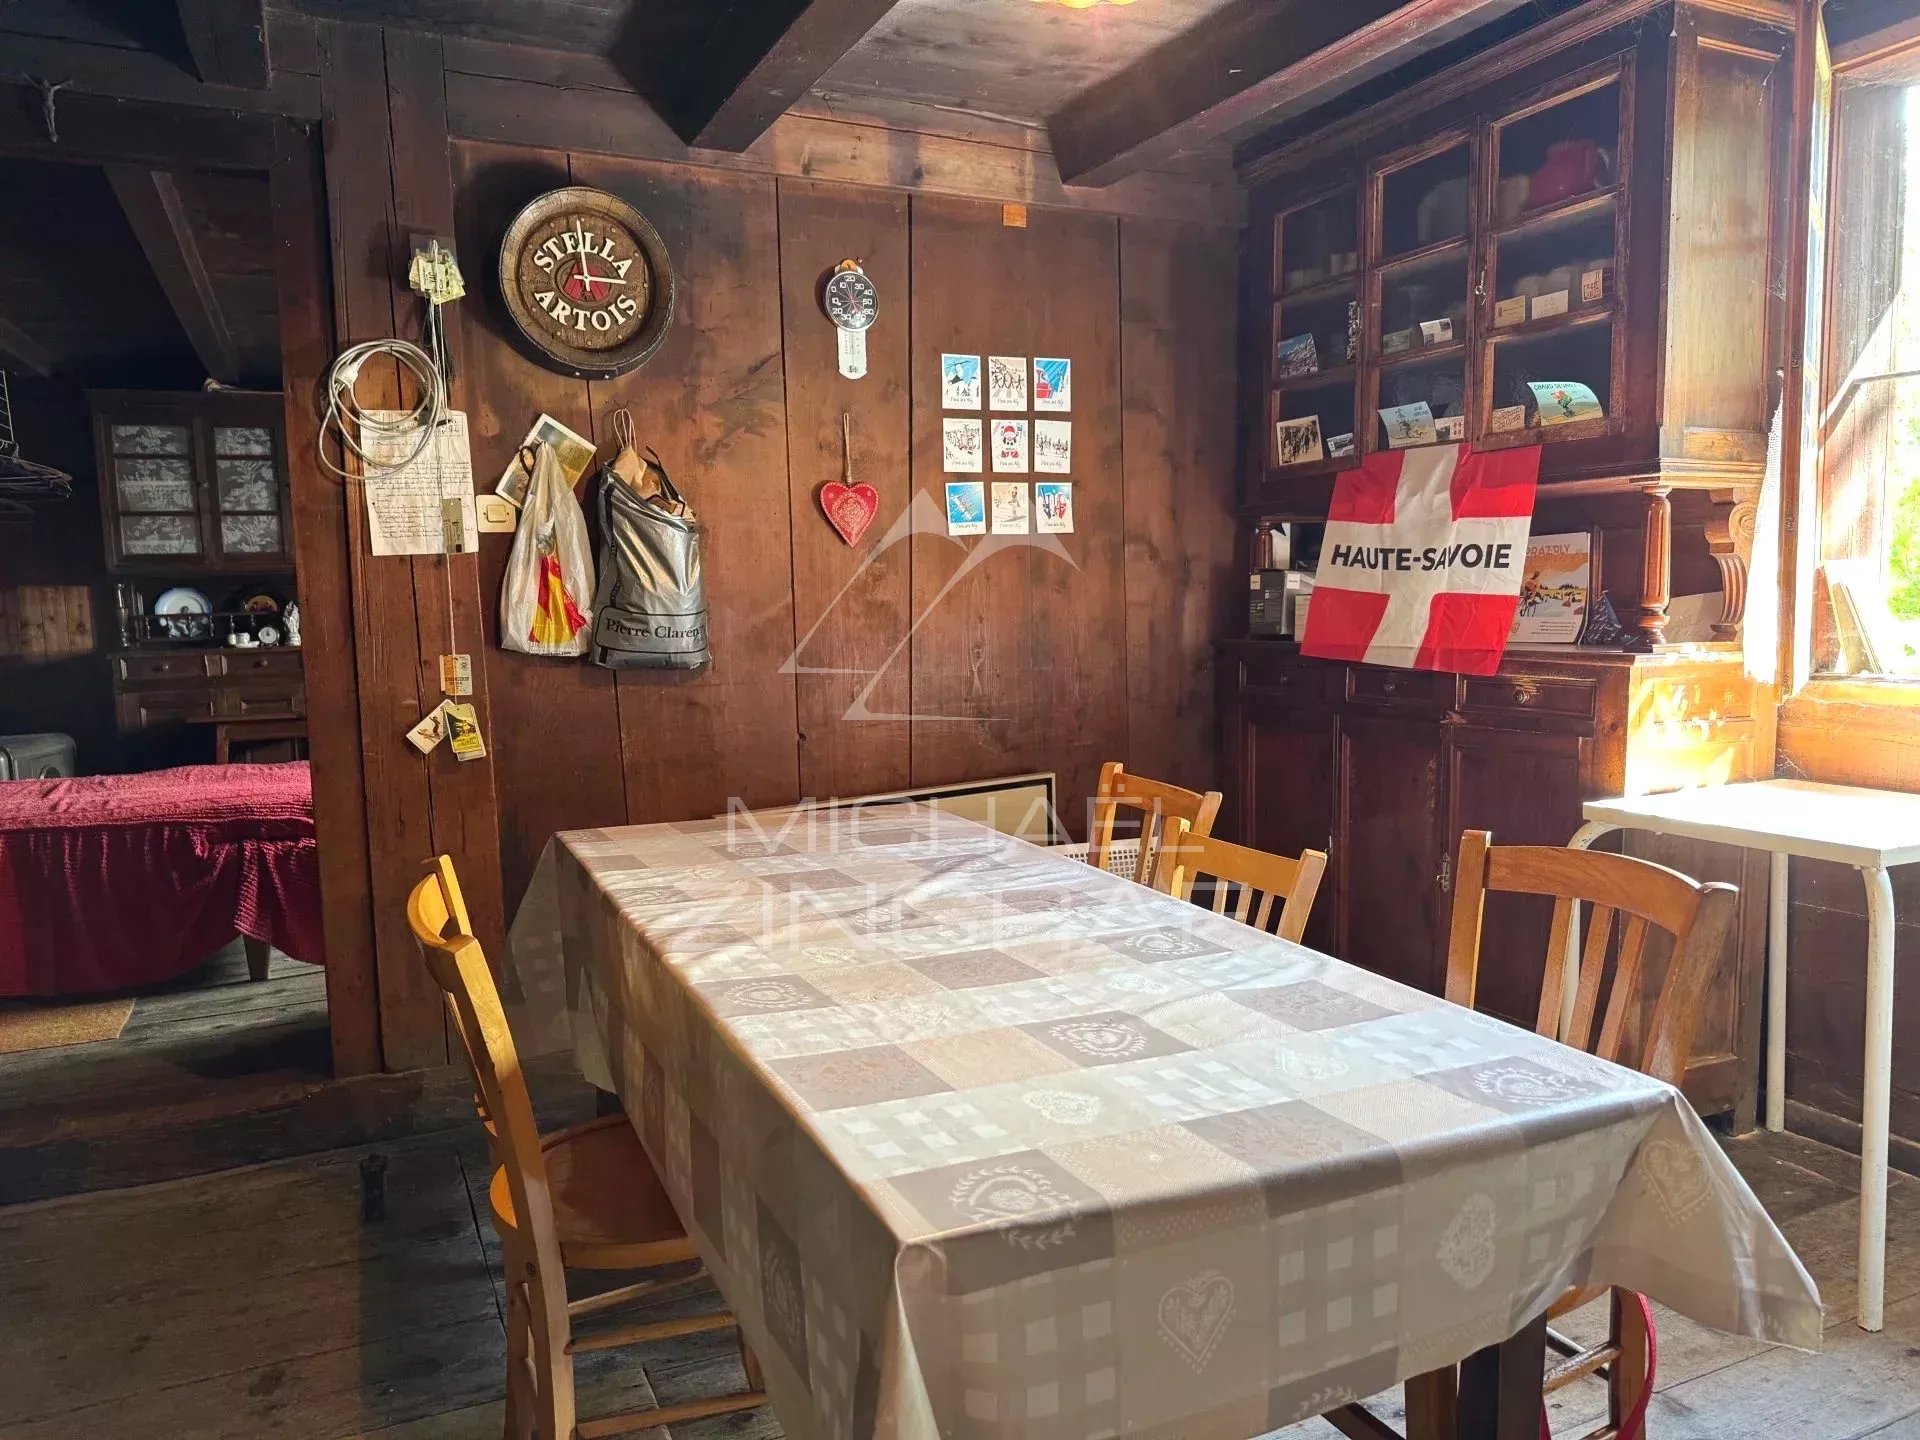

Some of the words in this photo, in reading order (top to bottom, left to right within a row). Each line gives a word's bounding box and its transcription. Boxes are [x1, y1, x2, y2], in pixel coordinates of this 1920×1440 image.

[533, 231, 633, 279] STELLA
[534, 291, 637, 331] ARTOIS
[1330, 543, 1512, 571] HAUTE-SAVOIE
[606, 617, 650, 637] Pierre
